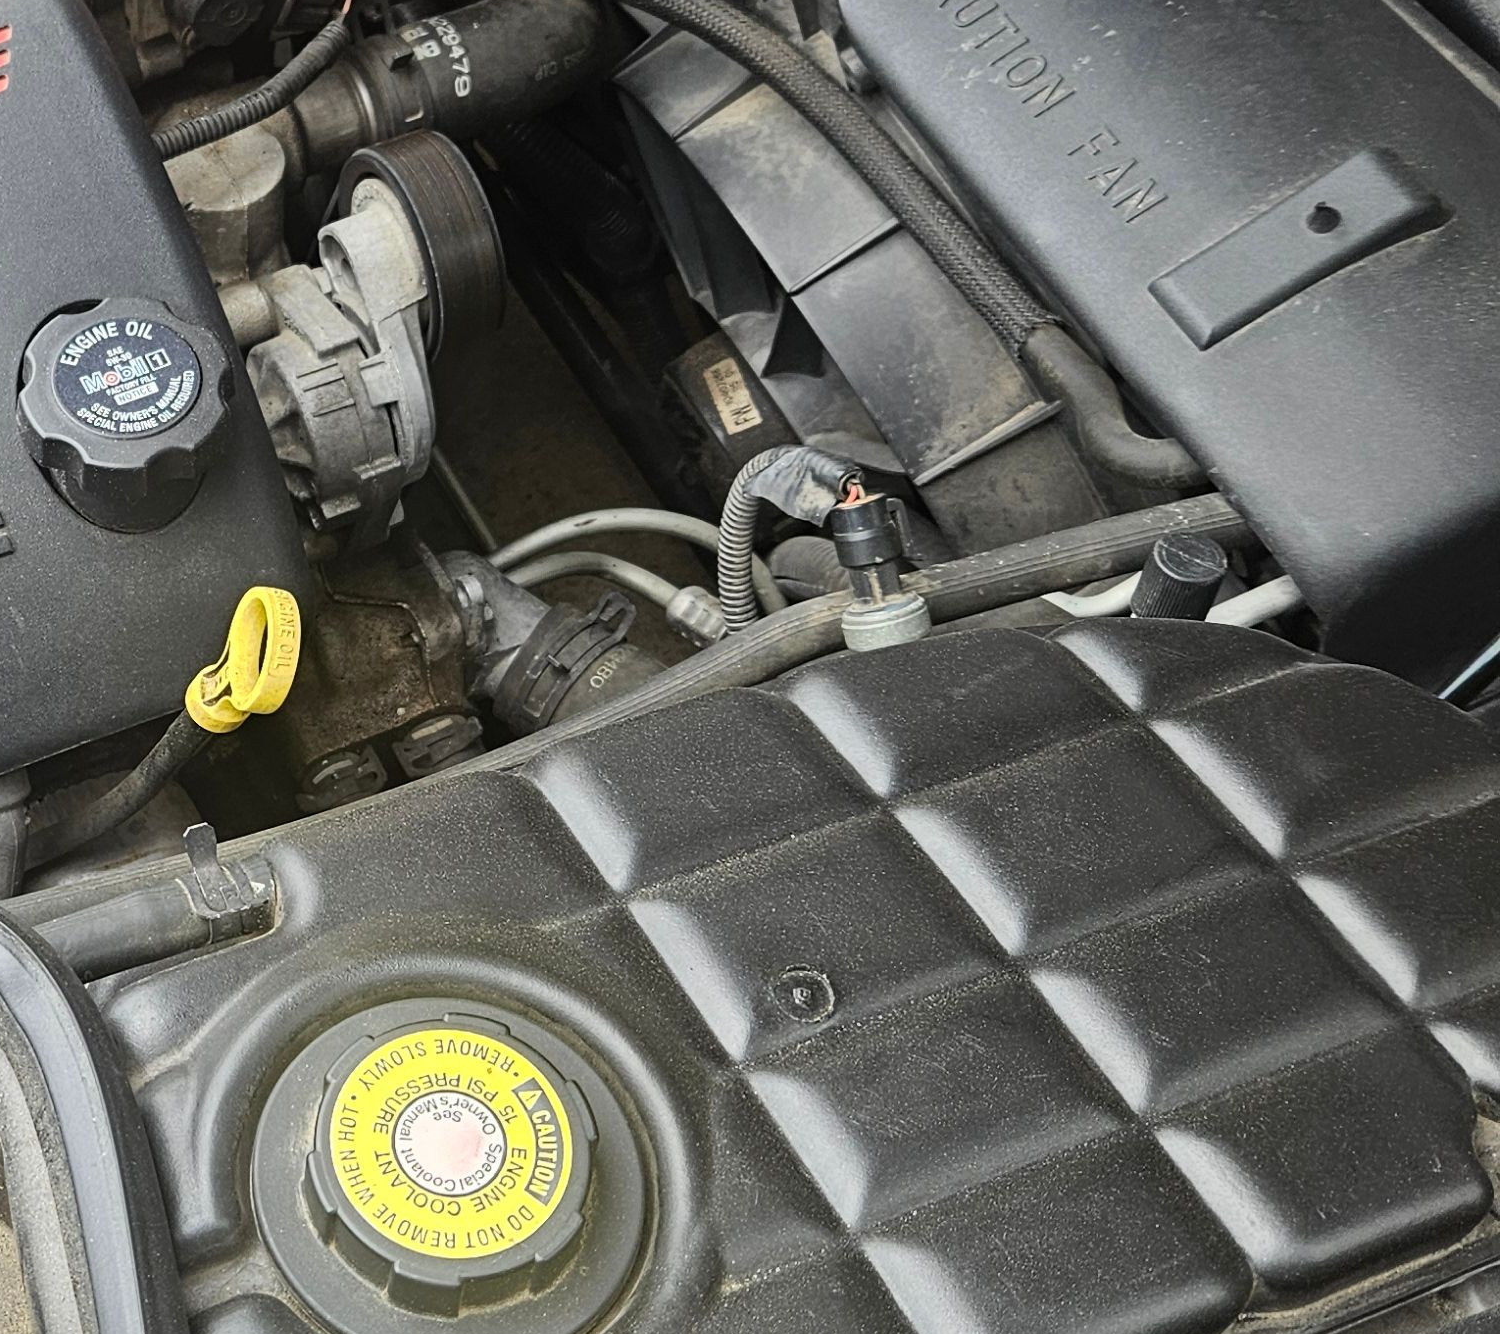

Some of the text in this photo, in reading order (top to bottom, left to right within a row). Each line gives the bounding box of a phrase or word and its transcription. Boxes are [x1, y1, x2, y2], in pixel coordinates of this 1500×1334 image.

[1066, 125, 1170, 226] FAN
[60, 321, 153, 366] ENGINE OIL
[79, 356, 148, 395] Mobil
[90, 403, 111, 418] SEE
[155, 375, 182, 409] MANUAL
[105, 373, 158, 396] FACTORY FILL
[118, 385, 154, 402] NOTICE
[76, 370, 196, 433] SPECIAL ENGINE OIL REQUIRED
[275, 644, 294, 670] OIL
[359, 1038, 515, 1092] REMOVE SLOWLY
[372, 1071, 515, 1136] 15 PSI PRESSURE
[399, 1095, 497, 1143] Owner's Manual
[432, 1109, 463, 1123] See
[338, 1104, 534, 1250] DO NOT REMOVE WHEN HOT
[398, 1142, 503, 1193] Special Coolant
[531, 1110, 558, 1196] CAUTION
[373, 1147, 527, 1217] ENGINE COOLANT
